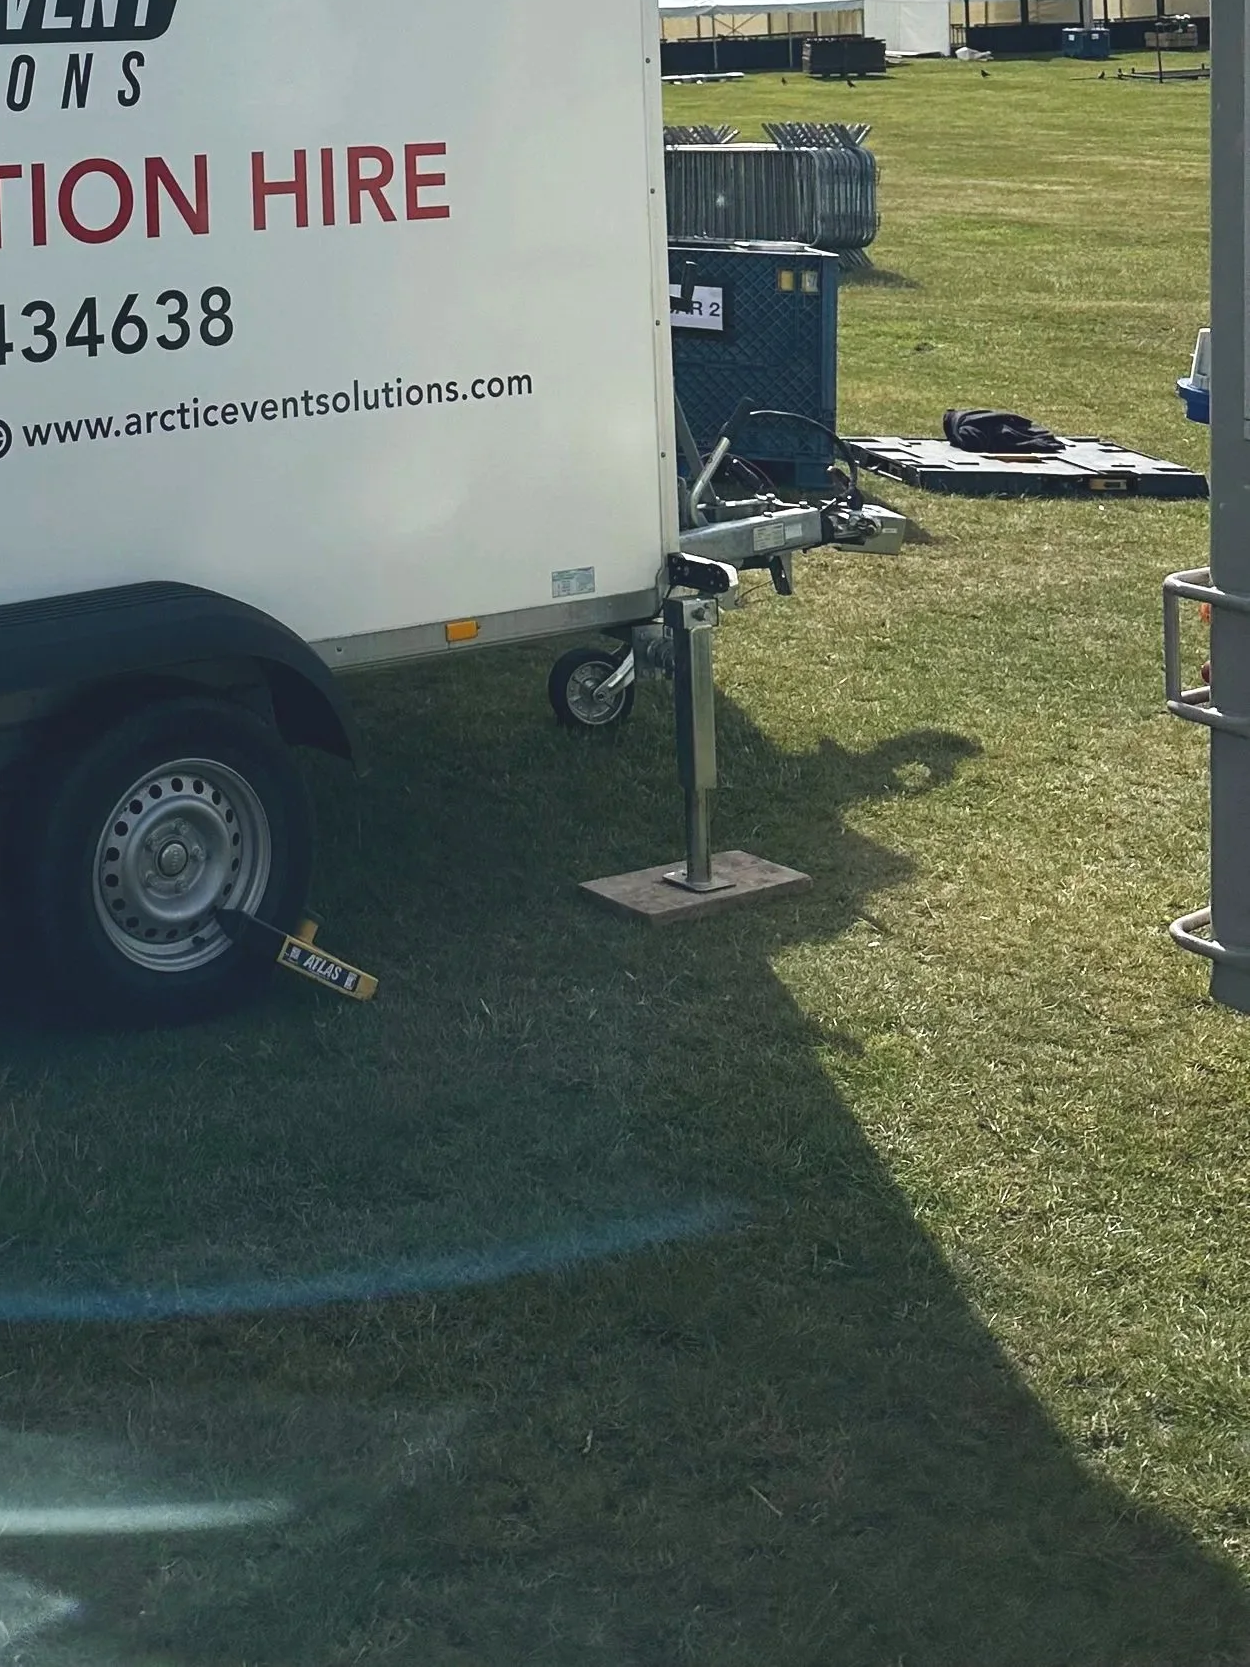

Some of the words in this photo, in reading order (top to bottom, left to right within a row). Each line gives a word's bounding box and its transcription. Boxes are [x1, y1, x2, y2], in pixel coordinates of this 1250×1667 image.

[251, 141, 451, 231] HIRE
[709, 302, 720, 317] 2
[21, 374, 533, 447] www.arcticeventsolutions.com
[303, 954, 342, 980] ATLAS
